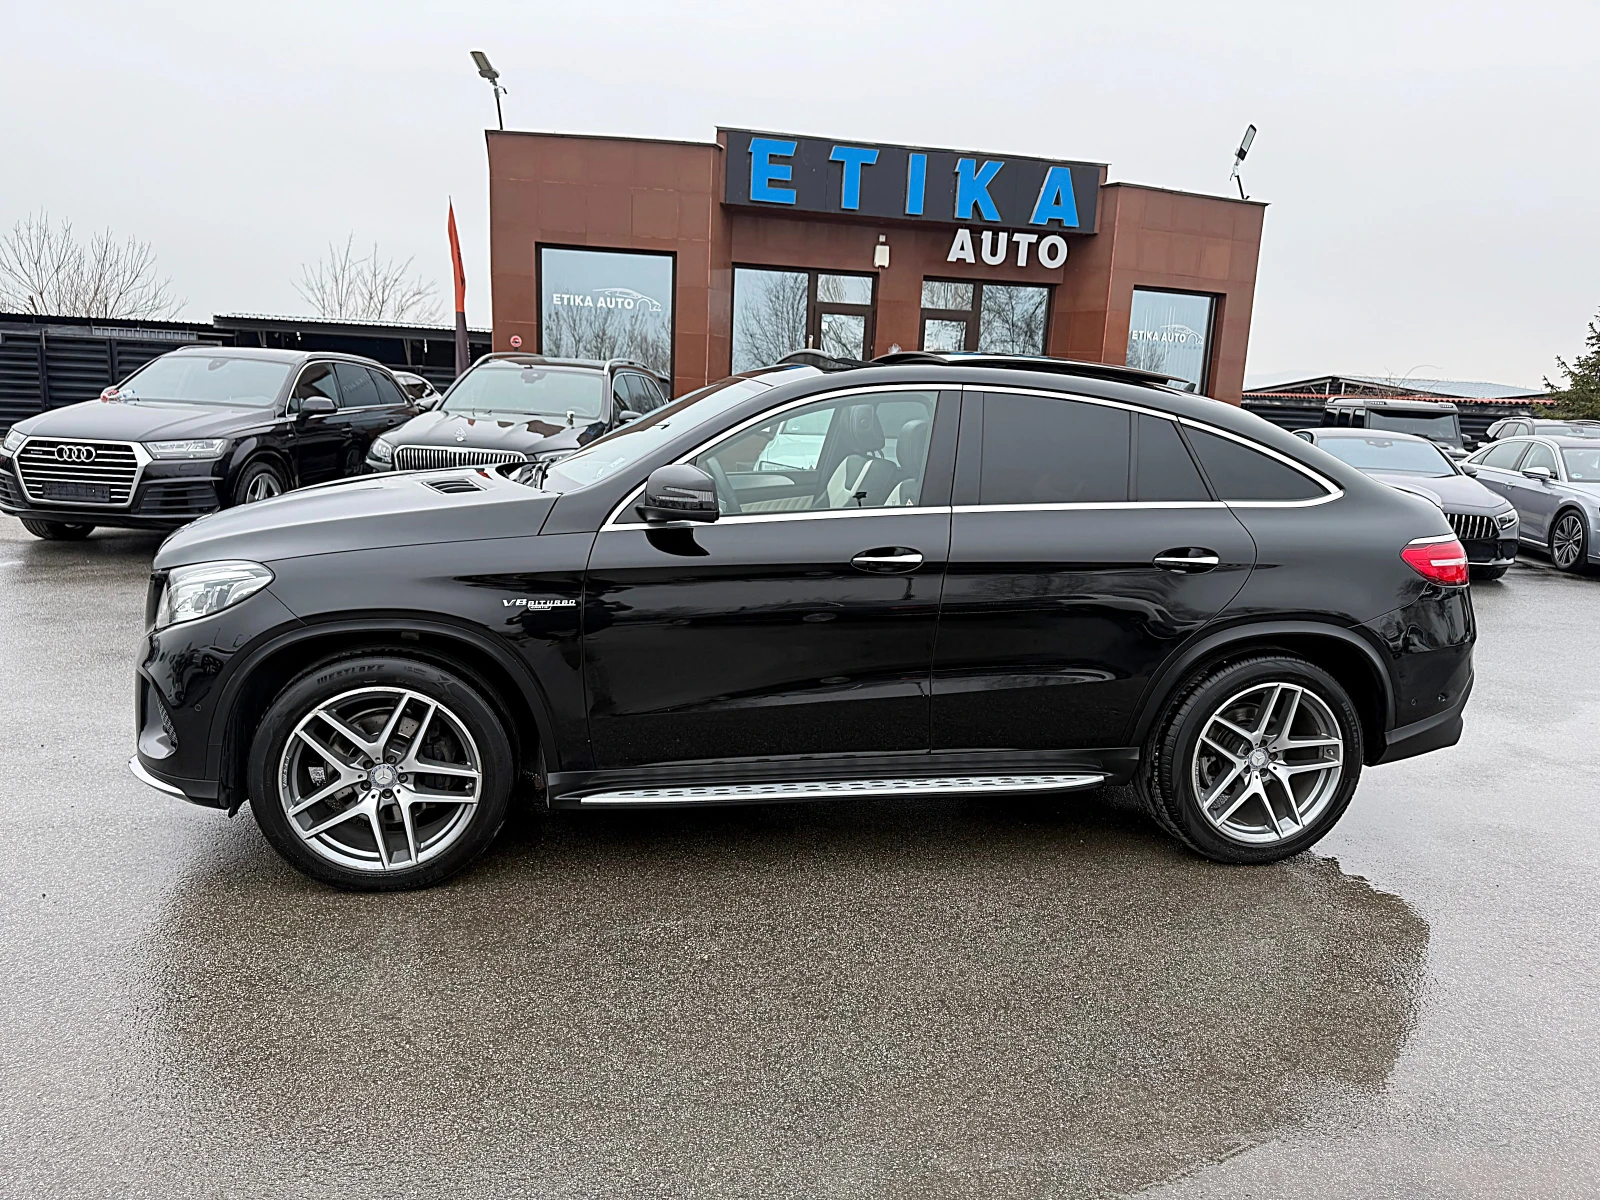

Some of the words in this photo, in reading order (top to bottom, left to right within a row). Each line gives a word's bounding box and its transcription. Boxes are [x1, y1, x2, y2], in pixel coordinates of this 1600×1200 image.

[748, 137, 1080, 228] ETIKA
[947, 228, 1068, 269] AUTO
[552, 293, 594, 308] ETIKA
[597, 296, 635, 310] AUTO
[1131, 329, 1159, 342] ETIKA
[1160, 331, 1187, 344] AUTO
